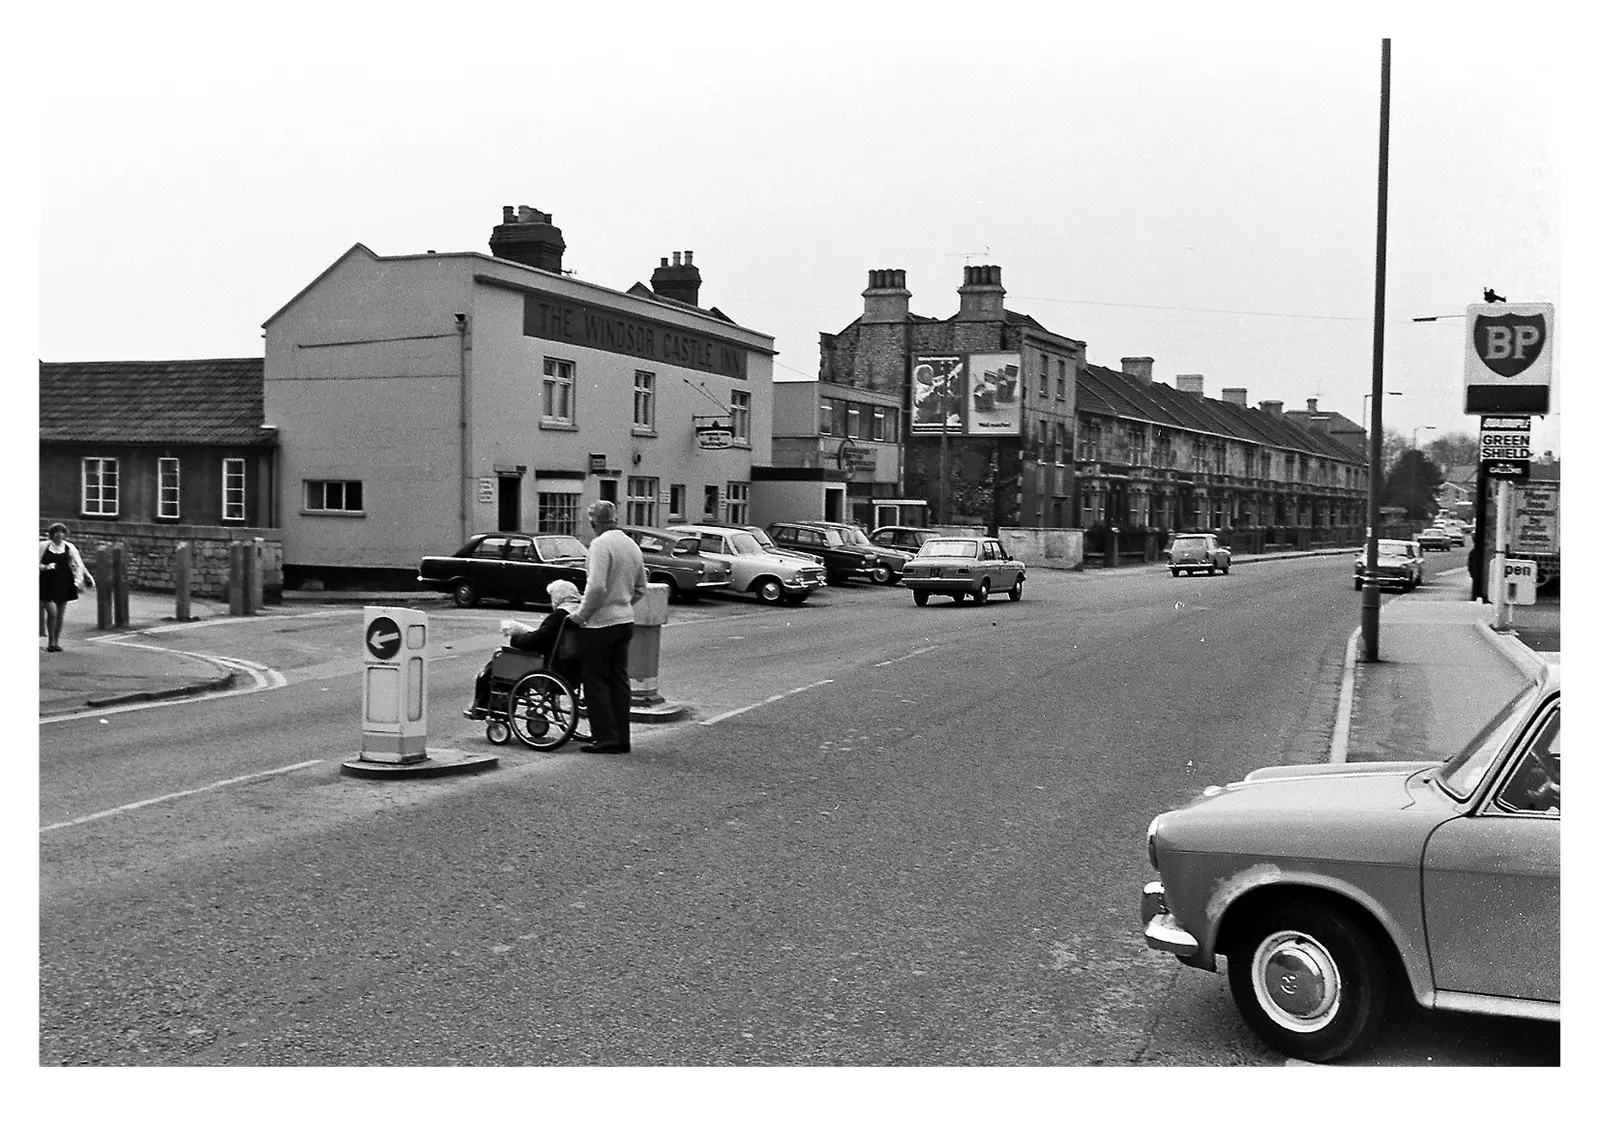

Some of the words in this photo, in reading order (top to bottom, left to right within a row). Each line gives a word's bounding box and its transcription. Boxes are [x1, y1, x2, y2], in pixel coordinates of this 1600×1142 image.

[539, 303, 573, 339] THE
[584, 313, 655, 353] WINDSOR
[663, 332, 713, 368] CASTLE
[720, 346, 740, 372] INN
[1484, 325, 1540, 360] BP
[1483, 434, 1531, 446] GREEN
[1482, 448, 1531, 459] SHIELD
[1504, 565, 1532, 578] pen
